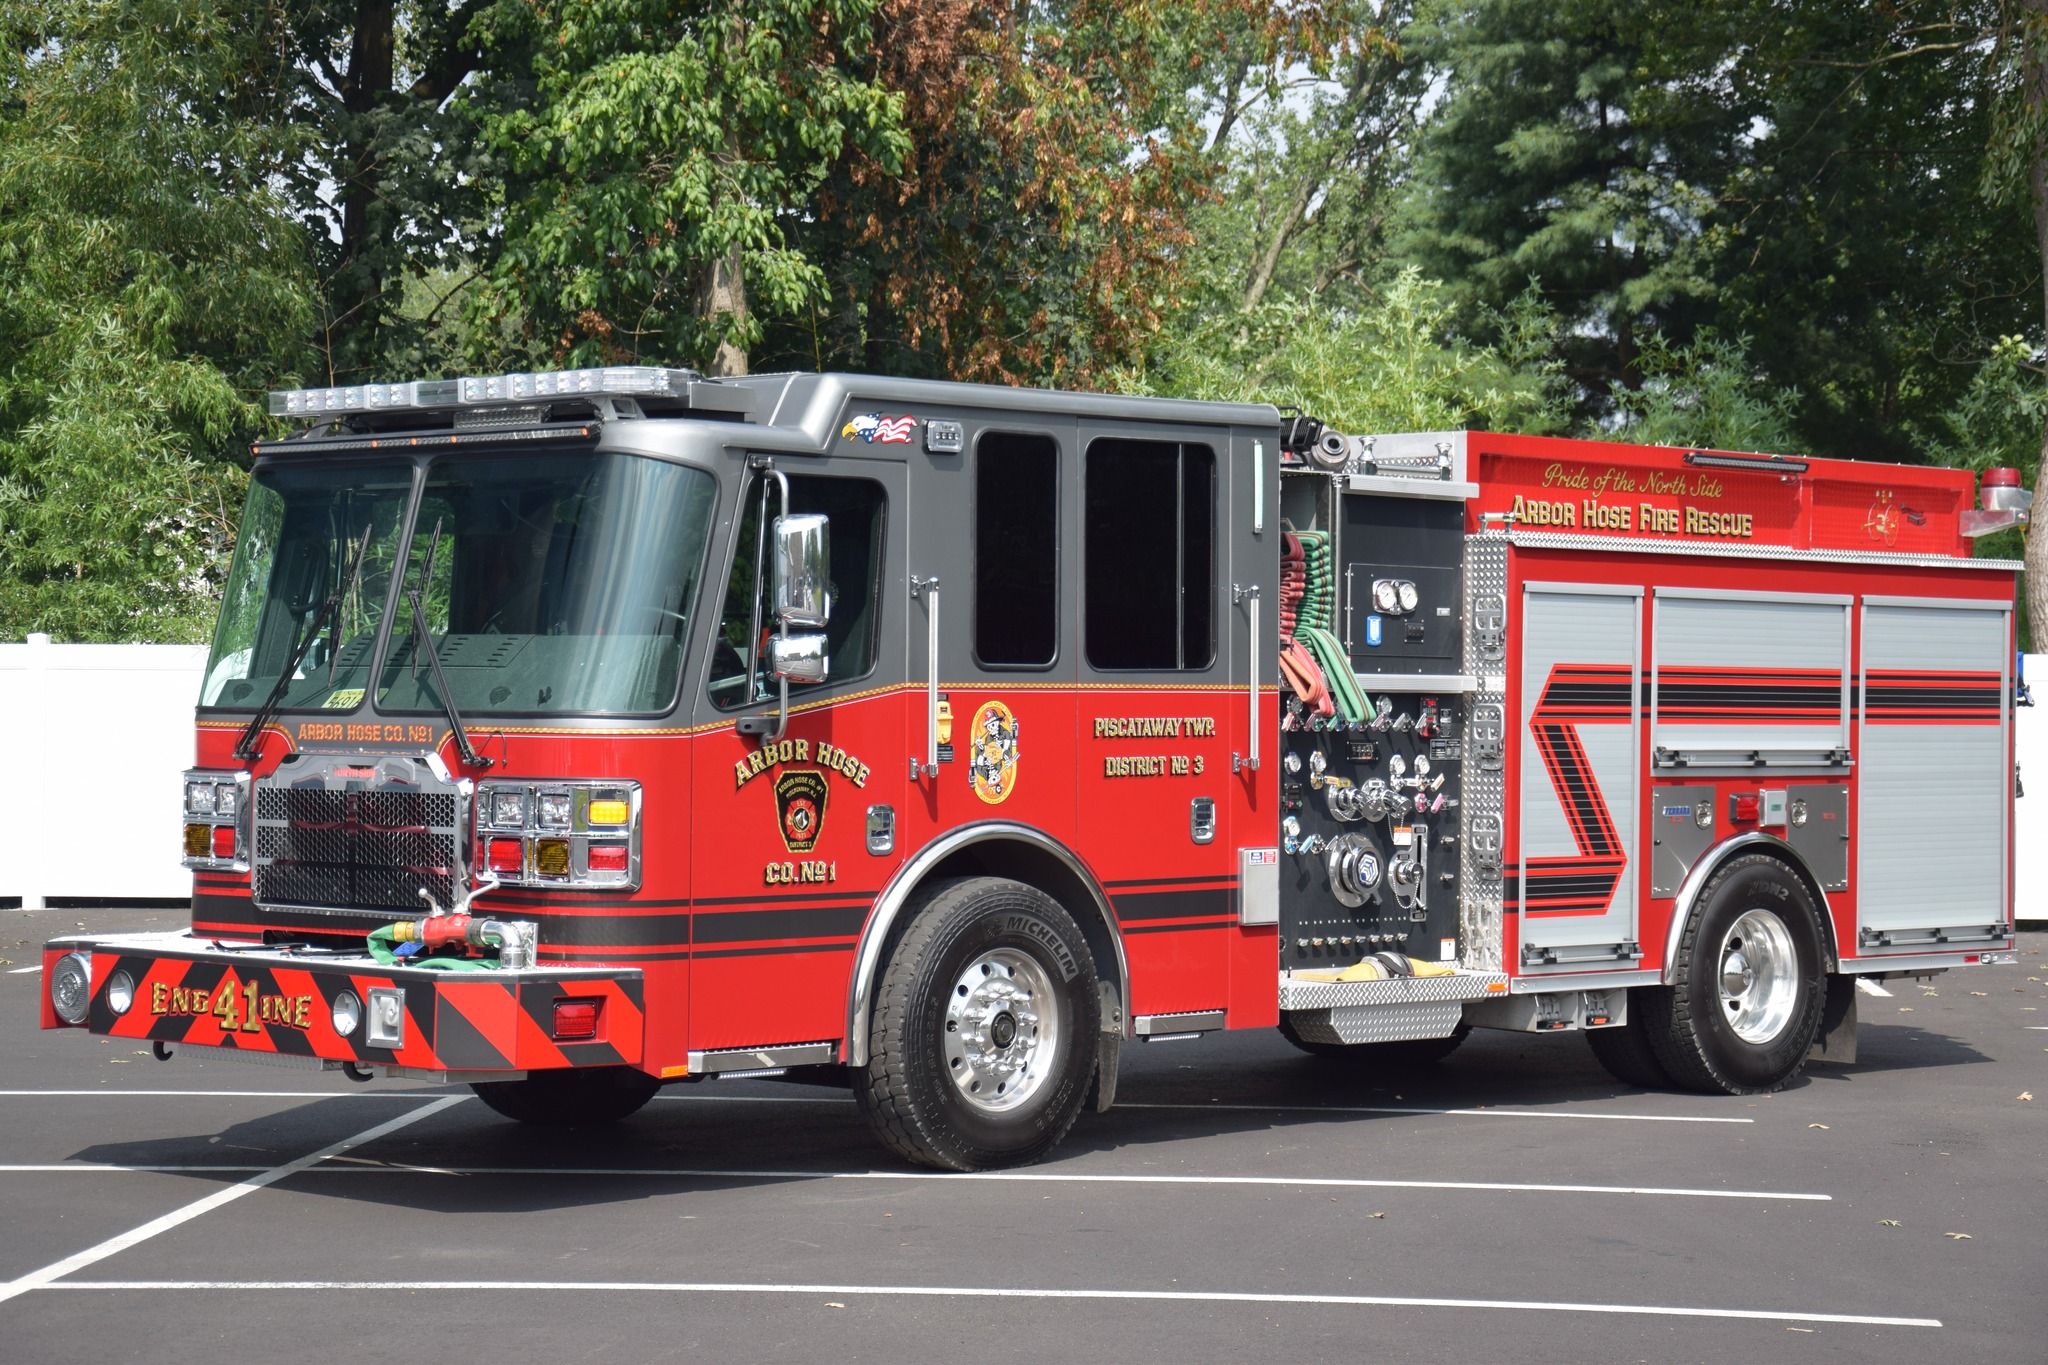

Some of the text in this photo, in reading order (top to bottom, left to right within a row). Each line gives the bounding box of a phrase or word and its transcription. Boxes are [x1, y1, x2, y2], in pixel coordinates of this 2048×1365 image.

[1542, 463, 1722, 498] Pride of the North Side
[1513, 495, 1753, 536] ARBOR HOSE FIRE RESCUE
[298, 723, 343, 740] ARBOR
[347, 724, 382, 741] HOSE
[384, 725, 406, 742] CO.
[1094, 717, 1216, 738] PISCATAWAY TWP.
[735, 739, 870, 788] ARBOR HOSE
[1105, 756, 1167, 776] DISTRICT
[1193, 755, 1204, 774] 3
[1006, 916, 1077, 976] MICHELIN
[213, 980, 261, 1032] 41
